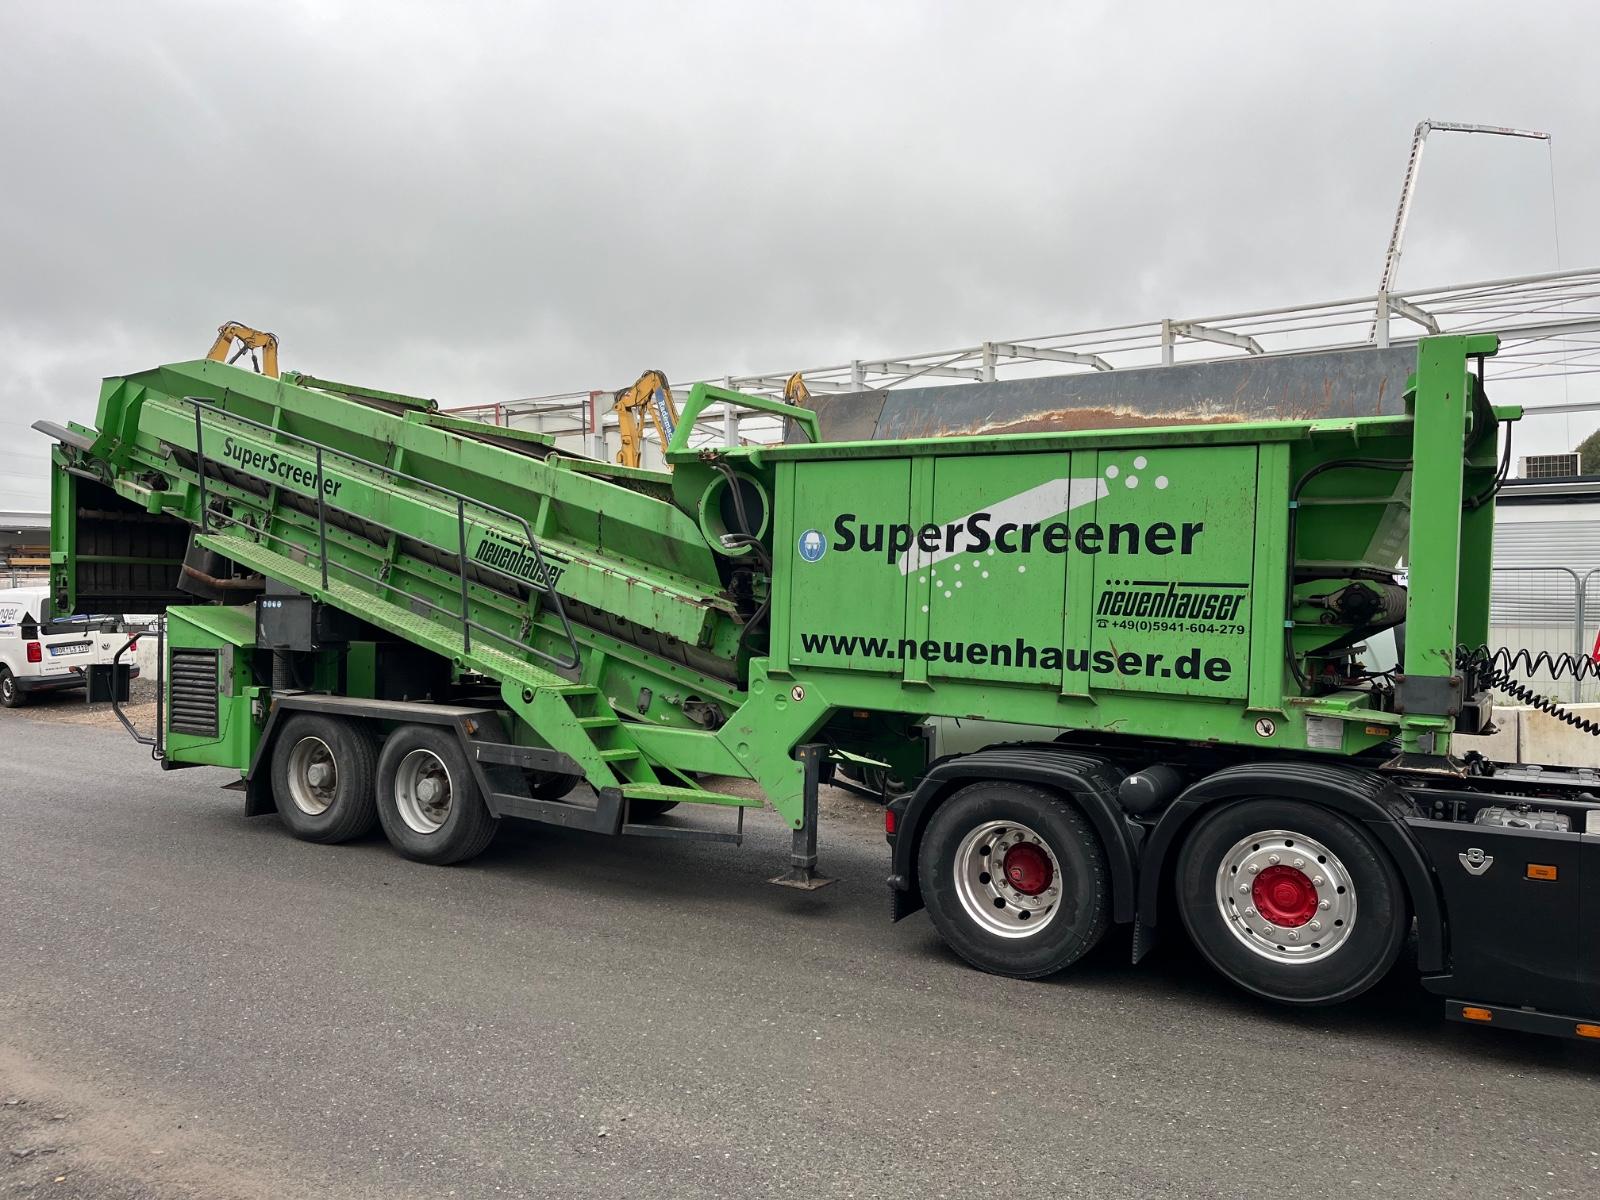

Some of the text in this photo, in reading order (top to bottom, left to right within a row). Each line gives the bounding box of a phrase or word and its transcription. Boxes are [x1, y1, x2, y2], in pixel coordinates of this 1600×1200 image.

[833, 513, 1204, 565] SuperScreener
[1096, 582, 1246, 621] neuenhauser
[1111, 620, 1245, 635] +49(0)5941-604-279
[800, 633, 1232, 682] www.neuenhauser.de
